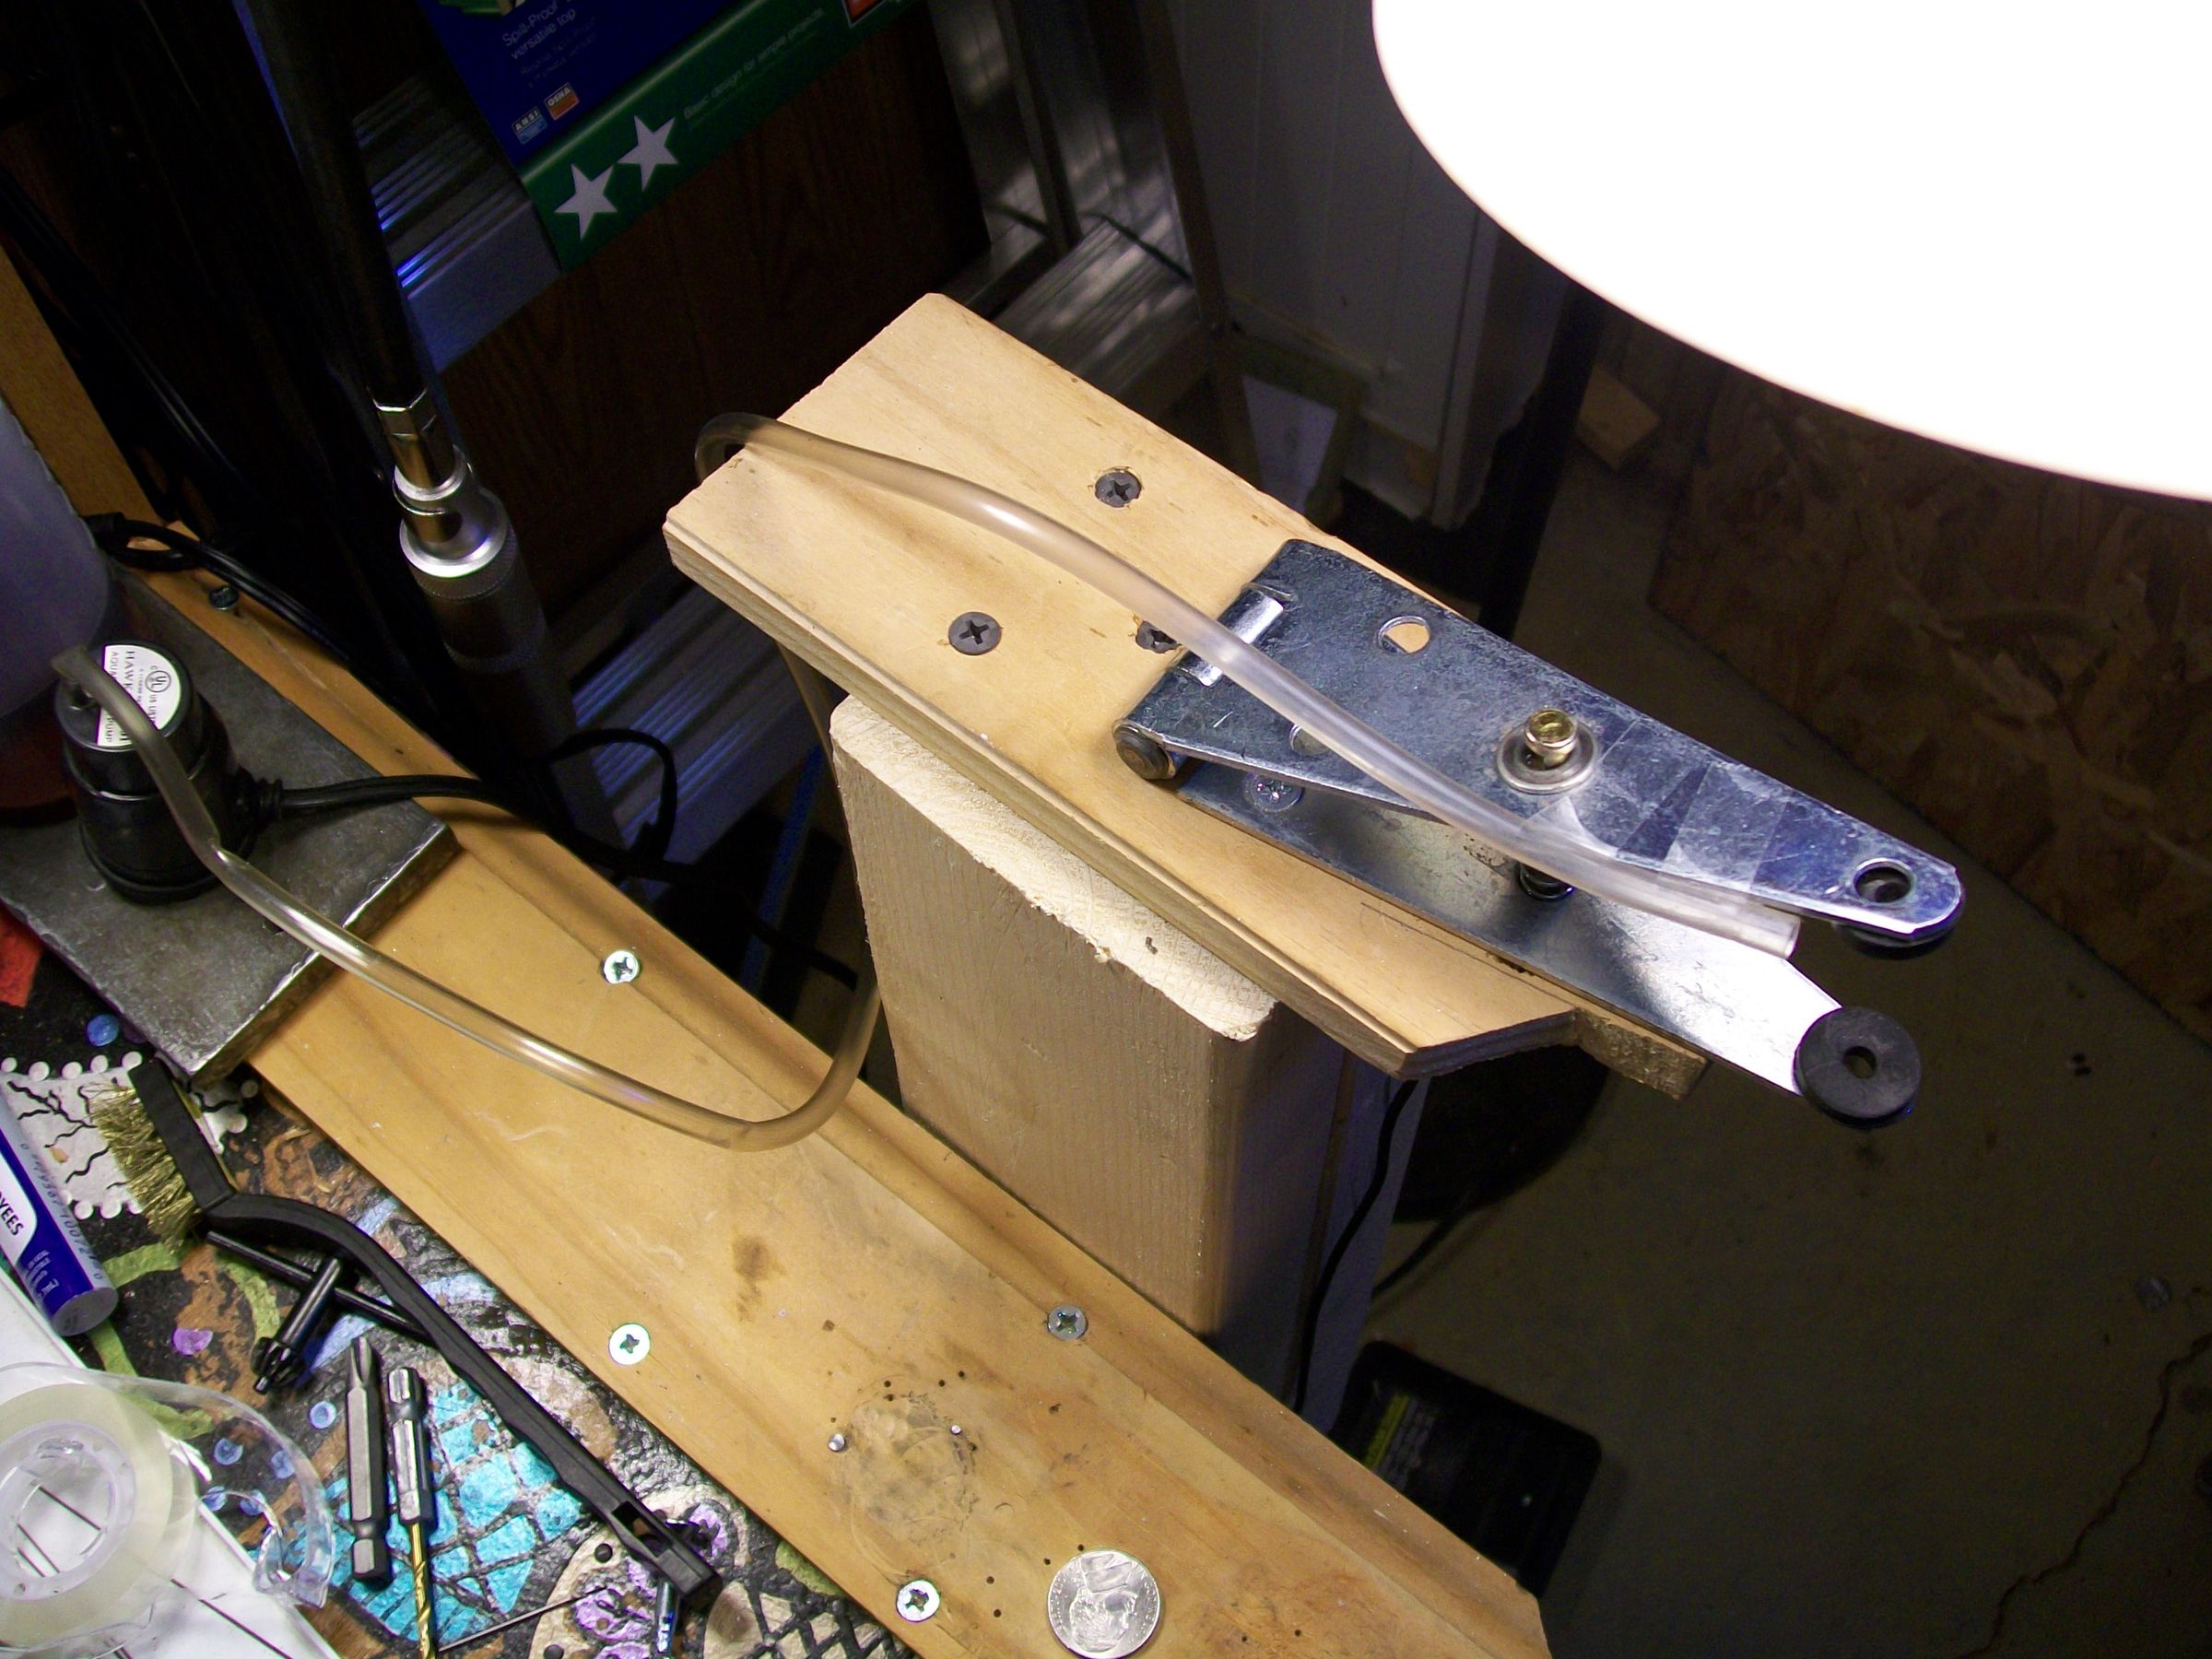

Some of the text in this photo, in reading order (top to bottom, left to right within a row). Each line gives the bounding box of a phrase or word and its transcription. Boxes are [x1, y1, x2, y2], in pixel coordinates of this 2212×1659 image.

[511, 22, 558, 60] versatile
[556, 7, 576, 28] top
[514, 109, 540, 131] ANSI
[0, 1190, 25, 1237] YEES
